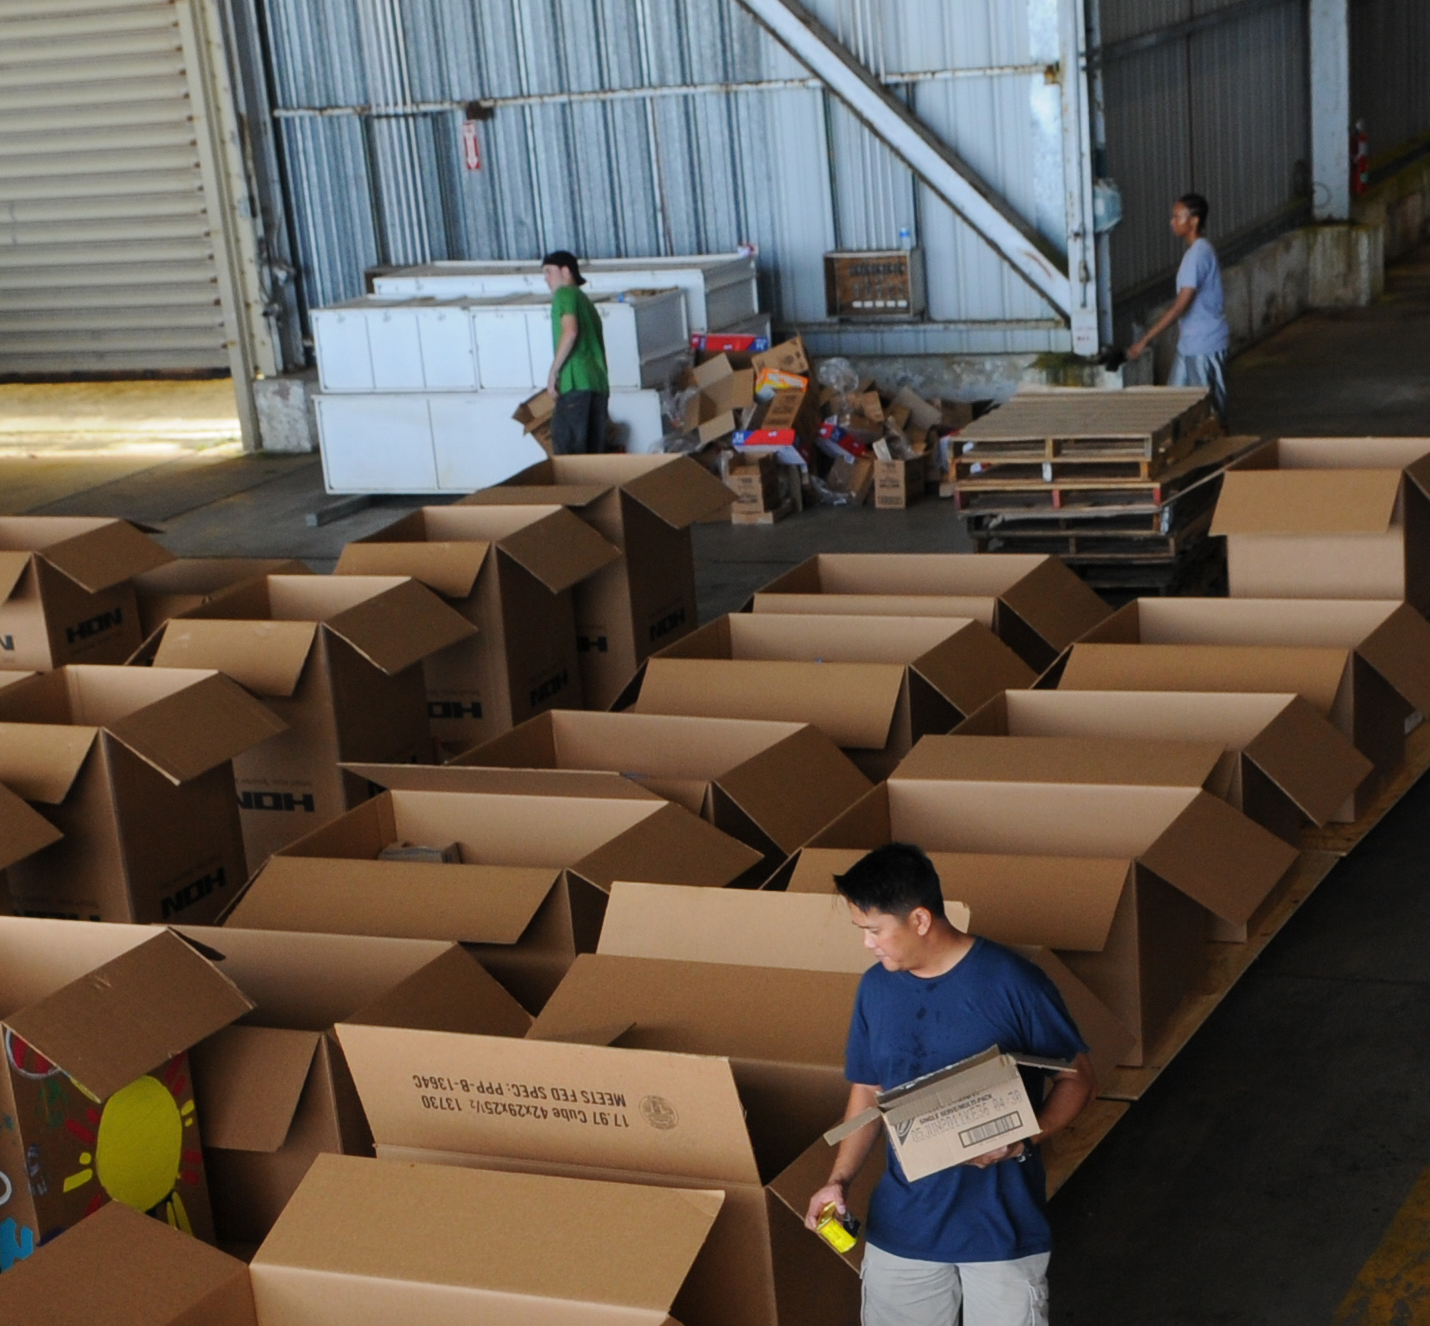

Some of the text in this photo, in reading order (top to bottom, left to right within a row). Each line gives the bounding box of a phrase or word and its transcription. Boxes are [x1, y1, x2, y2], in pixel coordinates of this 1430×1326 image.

[66, 608, 125, 643] HON
[427, 701, 483, 719] HO
[161, 866, 227, 919] HON
[412, 1074, 628, 1108] MEETS FED SPEC: PPP-B-1364C
[421, 1094, 464, 1112] 13730
[552, 1108, 588, 1124] Cube
[593, 1112, 630, 1128] 17.97
